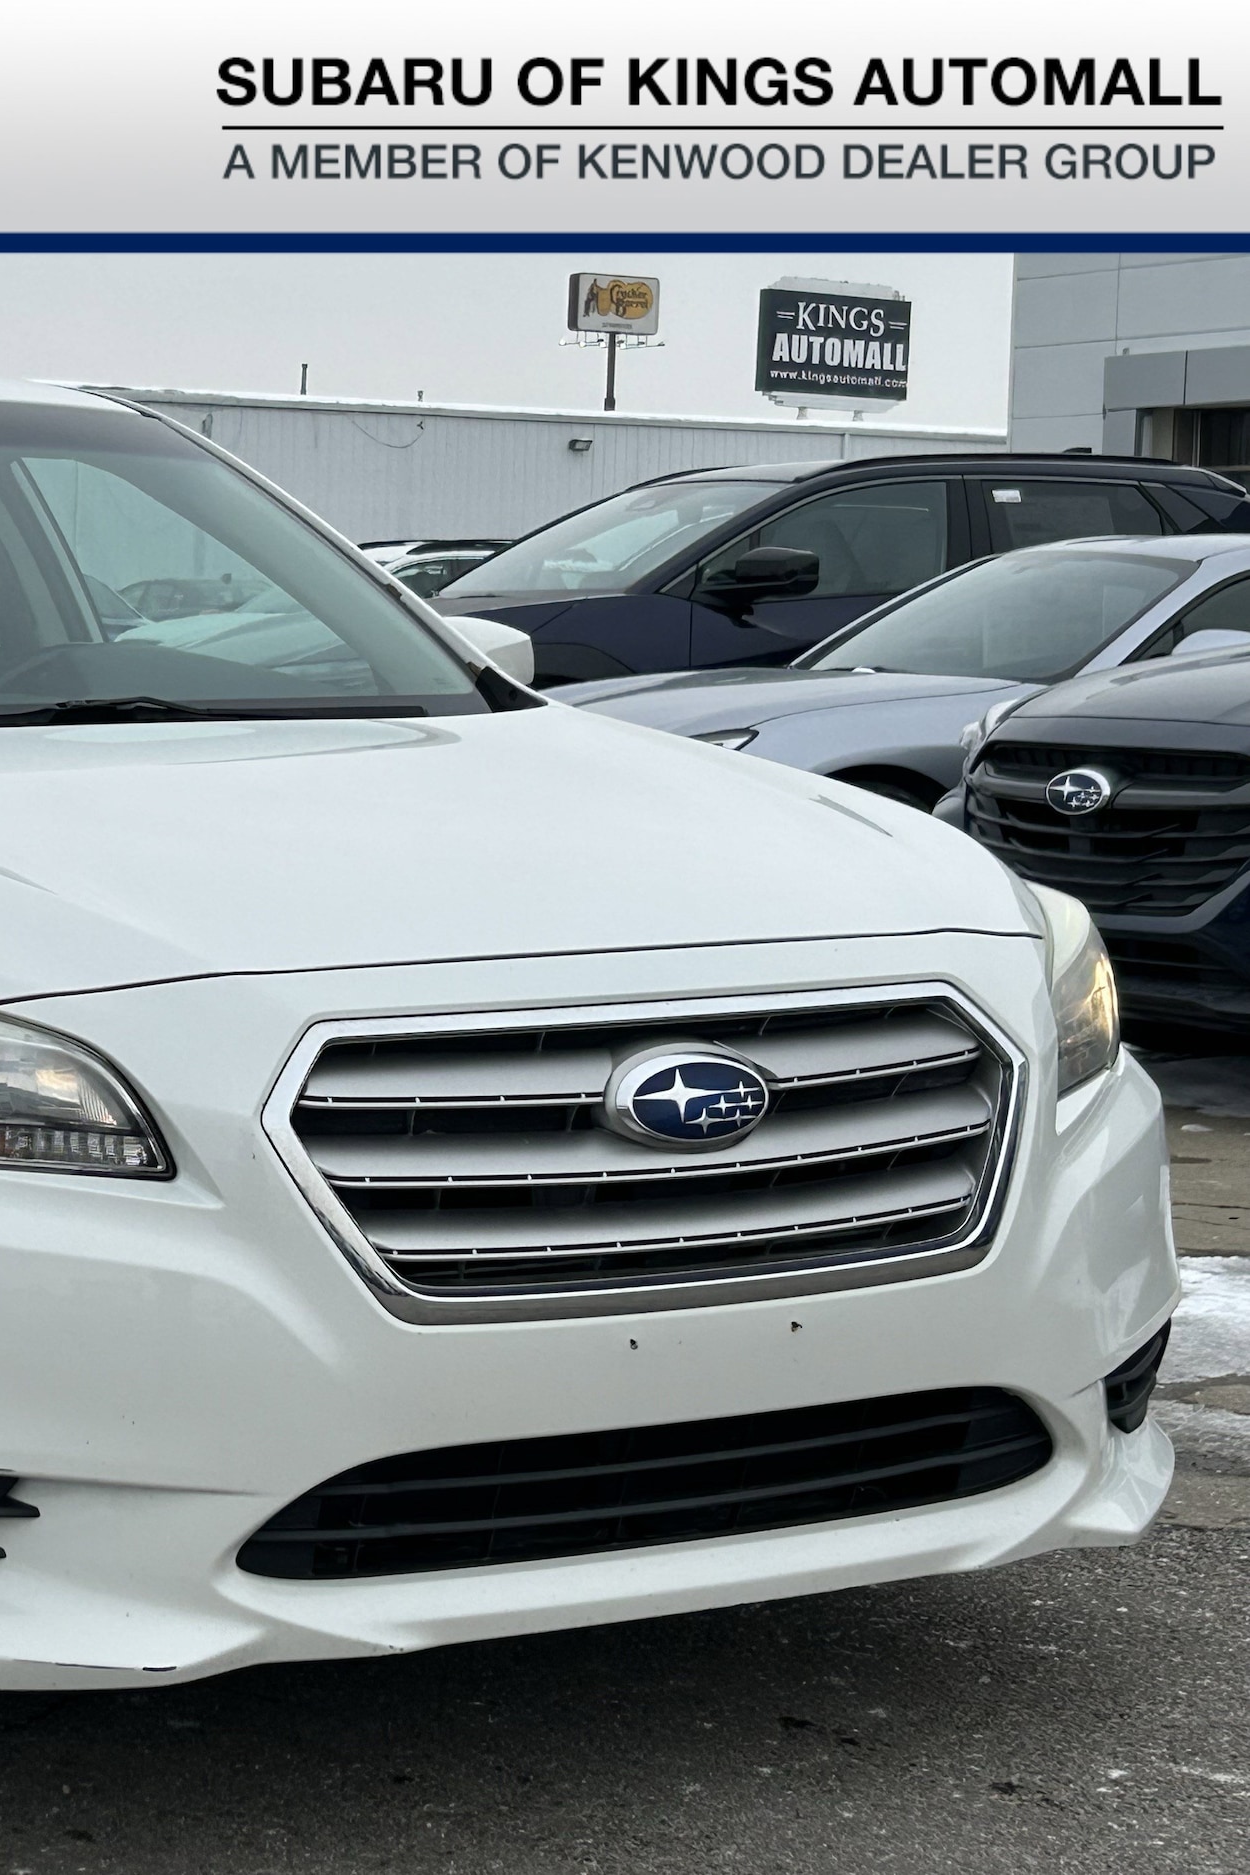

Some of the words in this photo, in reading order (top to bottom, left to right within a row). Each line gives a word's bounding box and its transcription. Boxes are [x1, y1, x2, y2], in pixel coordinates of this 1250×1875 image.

[796, 302, 885, 337] KINGS
[772, 333, 906, 371] AUTOMALL
[770, 370, 908, 388] www.kingsautomall.com
